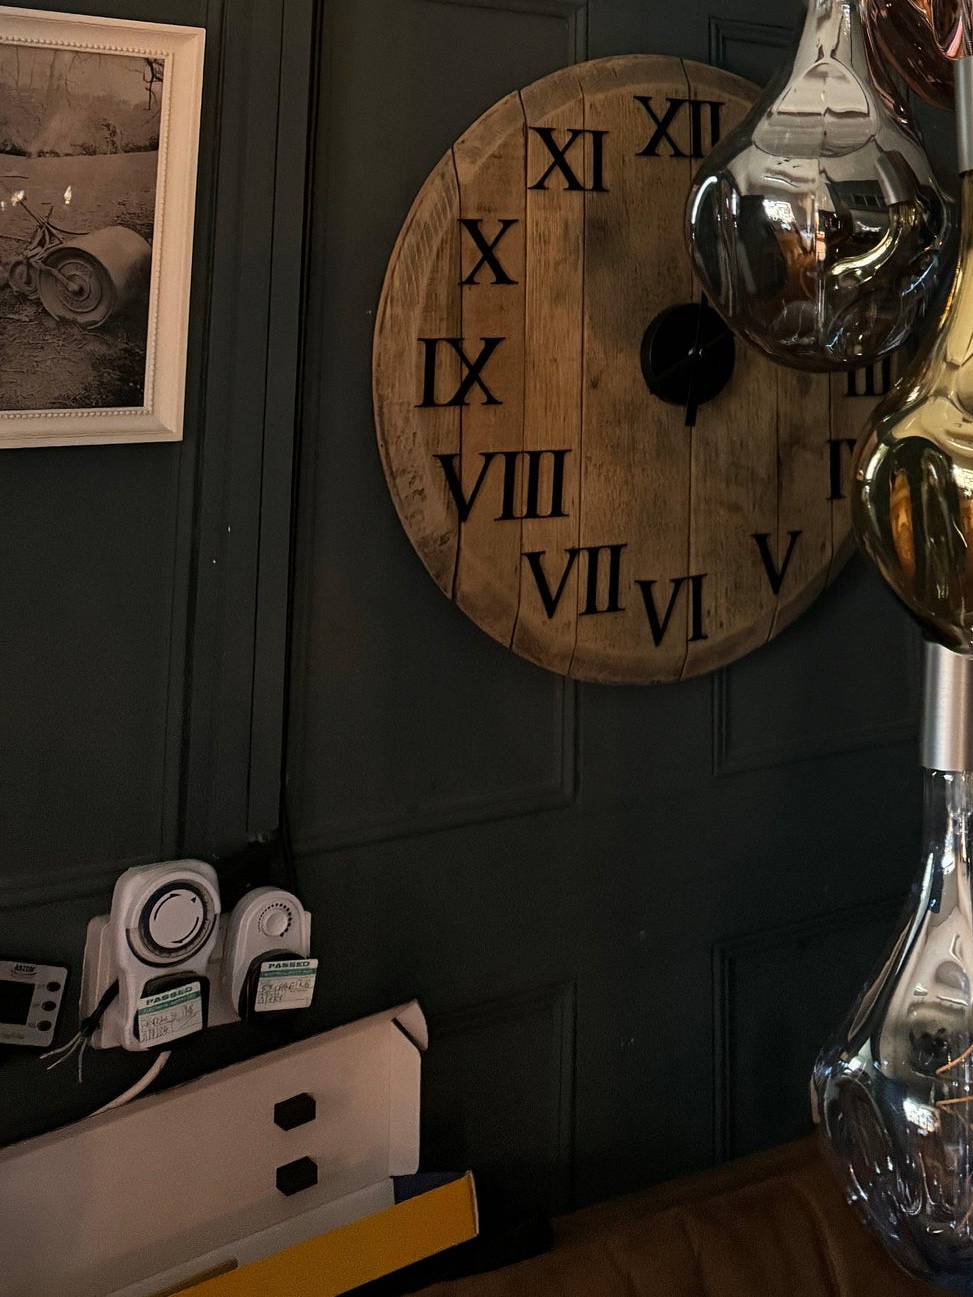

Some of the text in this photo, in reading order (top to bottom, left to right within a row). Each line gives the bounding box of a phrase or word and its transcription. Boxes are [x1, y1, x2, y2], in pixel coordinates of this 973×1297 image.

[528, 127, 609, 192] XI
[634, 96, 725, 158] XII
[459, 219, 519, 285] X
[415, 337, 506, 407] IX
[433, 449, 572, 522] VIII
[523, 545, 627, 618] VII
[753, 531, 800, 595] V
[635, 575, 708, 646] VI
[146, 986, 193, 1005] PASSED
[268, 961, 309, 969] PASSED
